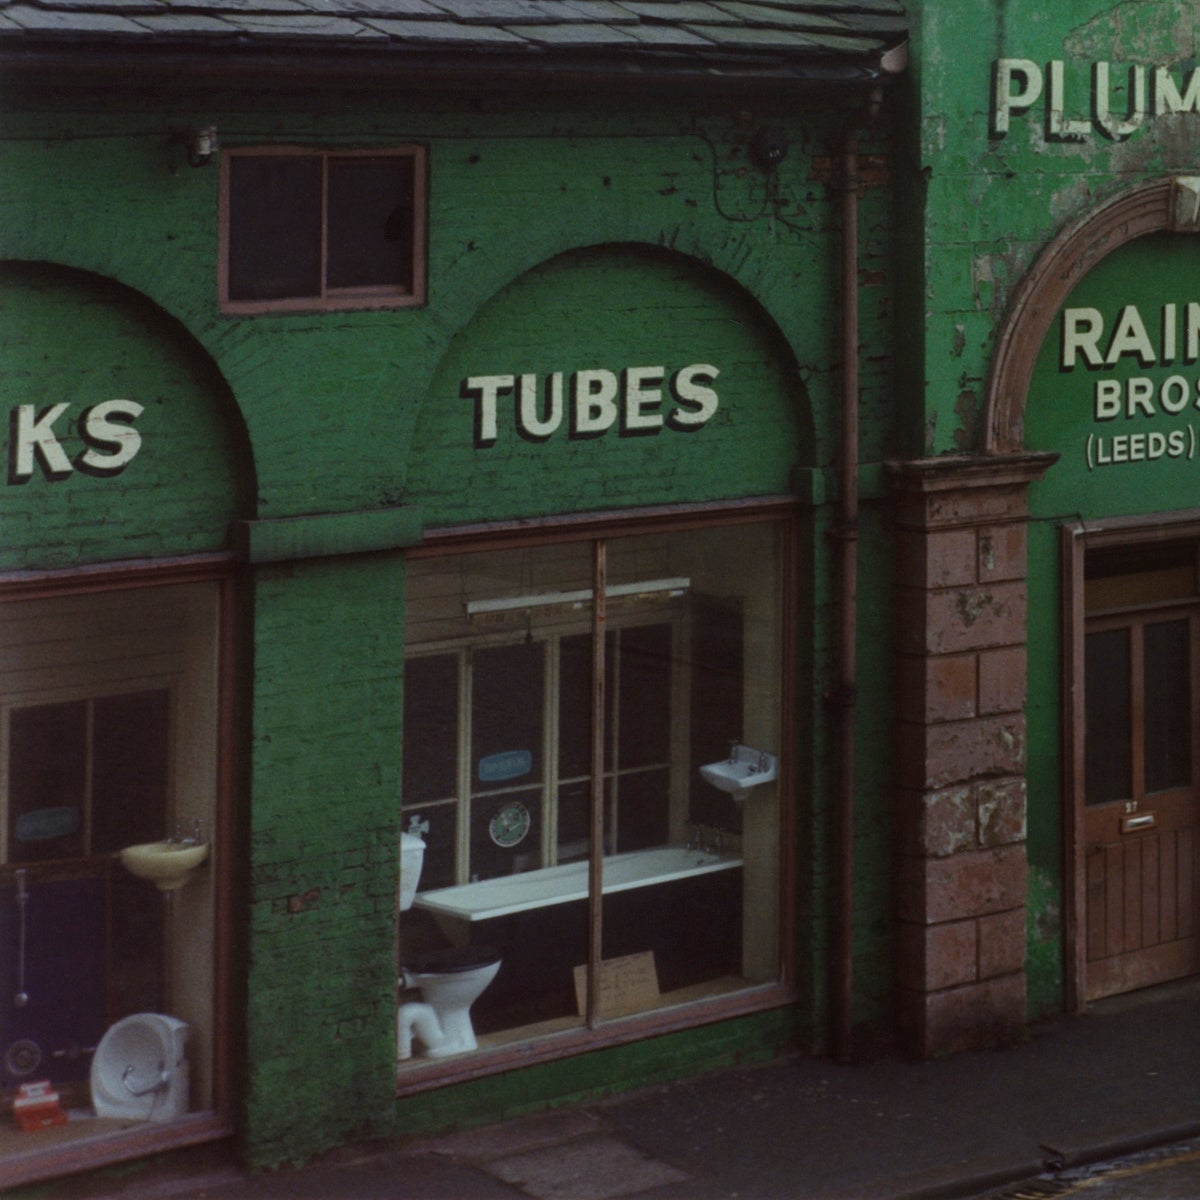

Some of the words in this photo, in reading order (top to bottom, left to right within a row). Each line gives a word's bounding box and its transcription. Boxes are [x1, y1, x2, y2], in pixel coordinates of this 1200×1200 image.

[15, 399, 146, 476] KS
[467, 363, 721, 441] TUBES
[1087, 424, 1196, 469] (LEEDS)
